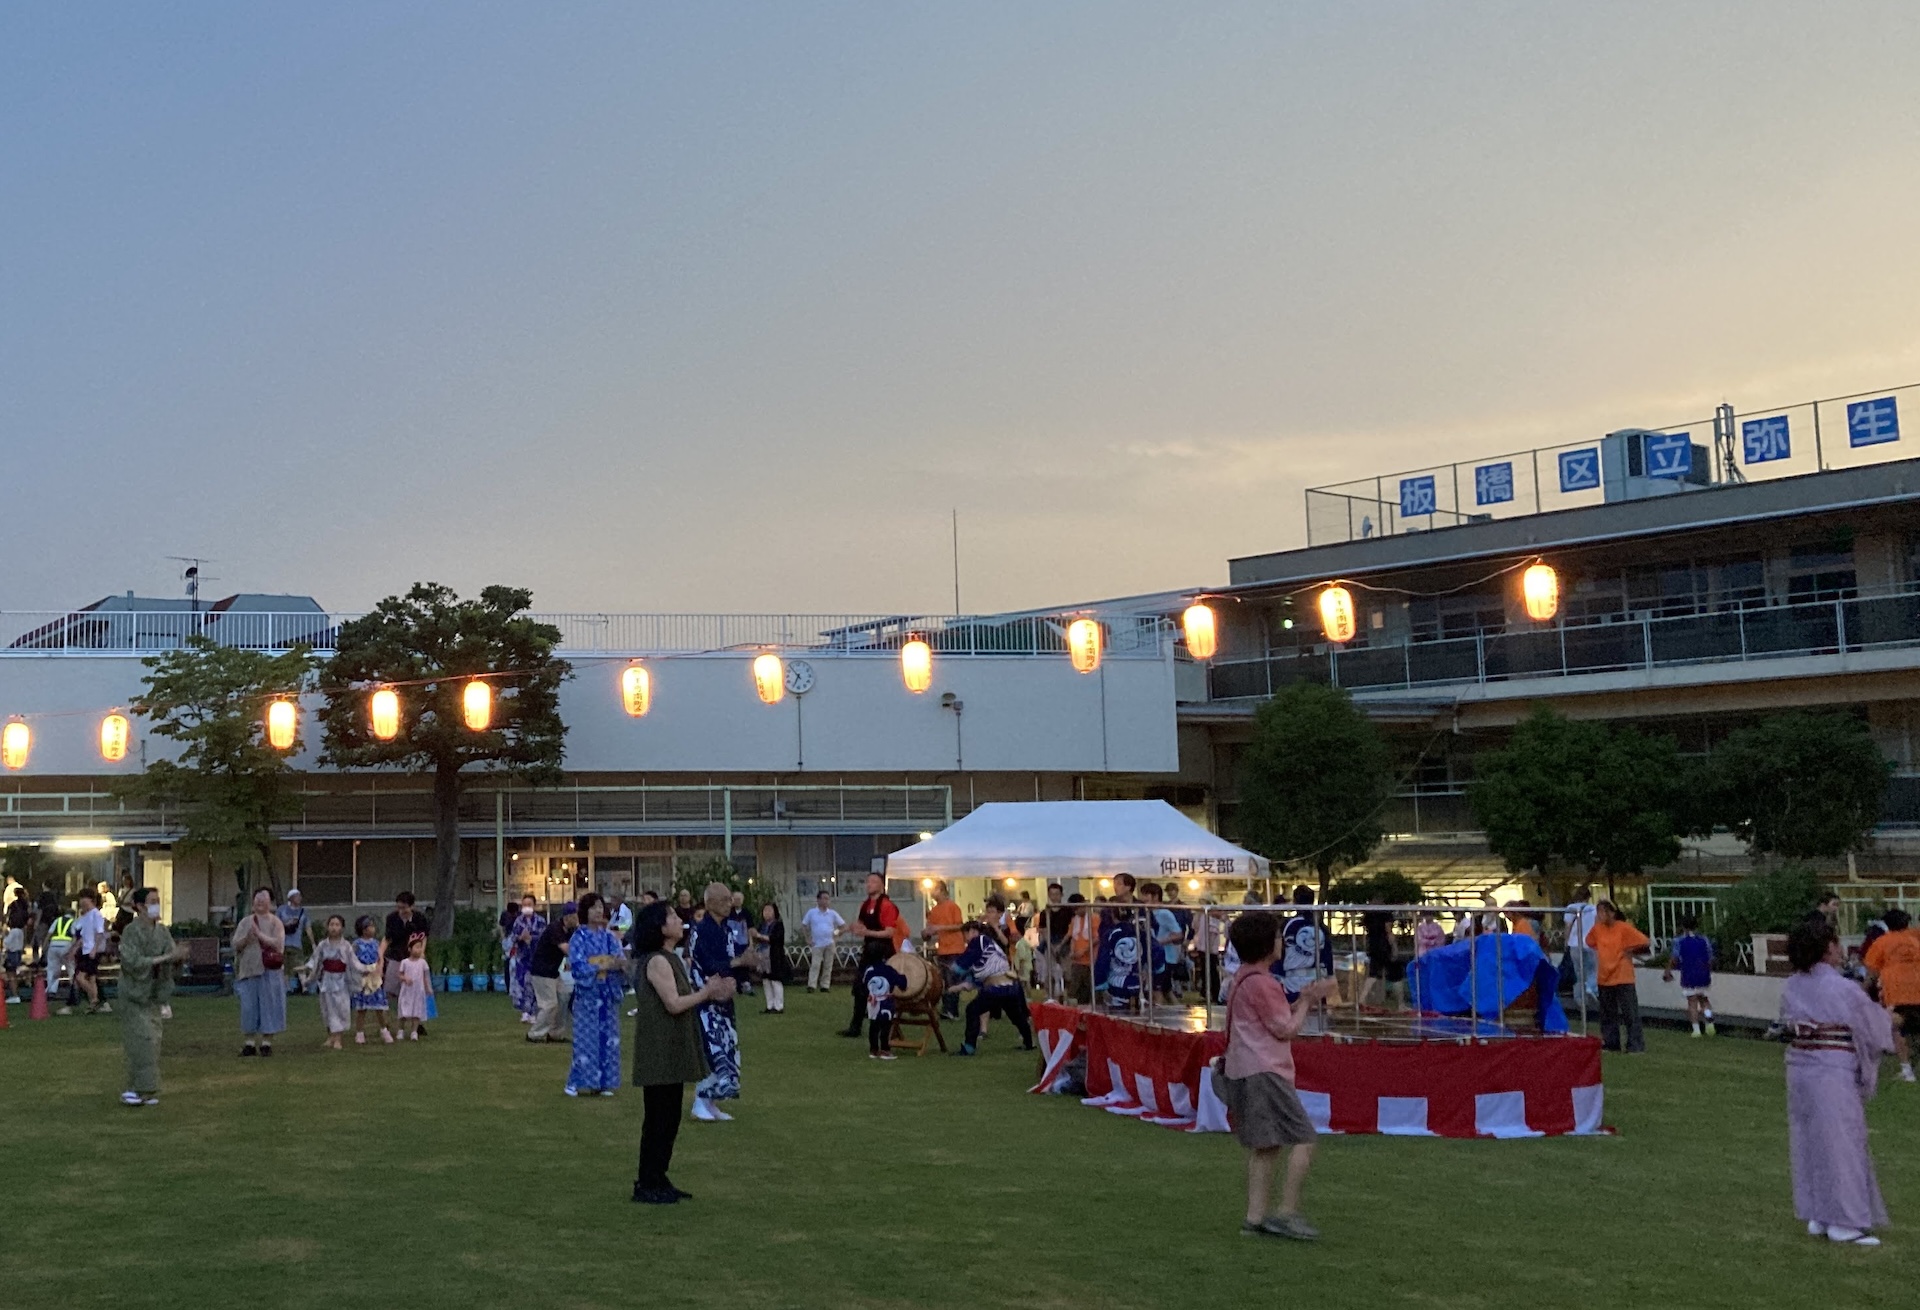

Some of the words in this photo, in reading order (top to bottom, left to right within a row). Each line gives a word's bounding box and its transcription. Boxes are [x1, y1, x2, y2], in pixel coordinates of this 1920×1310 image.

[1402, 401, 1892, 514] 板橋区立弥生
[1160, 857, 1235, 875] 仲町支部
